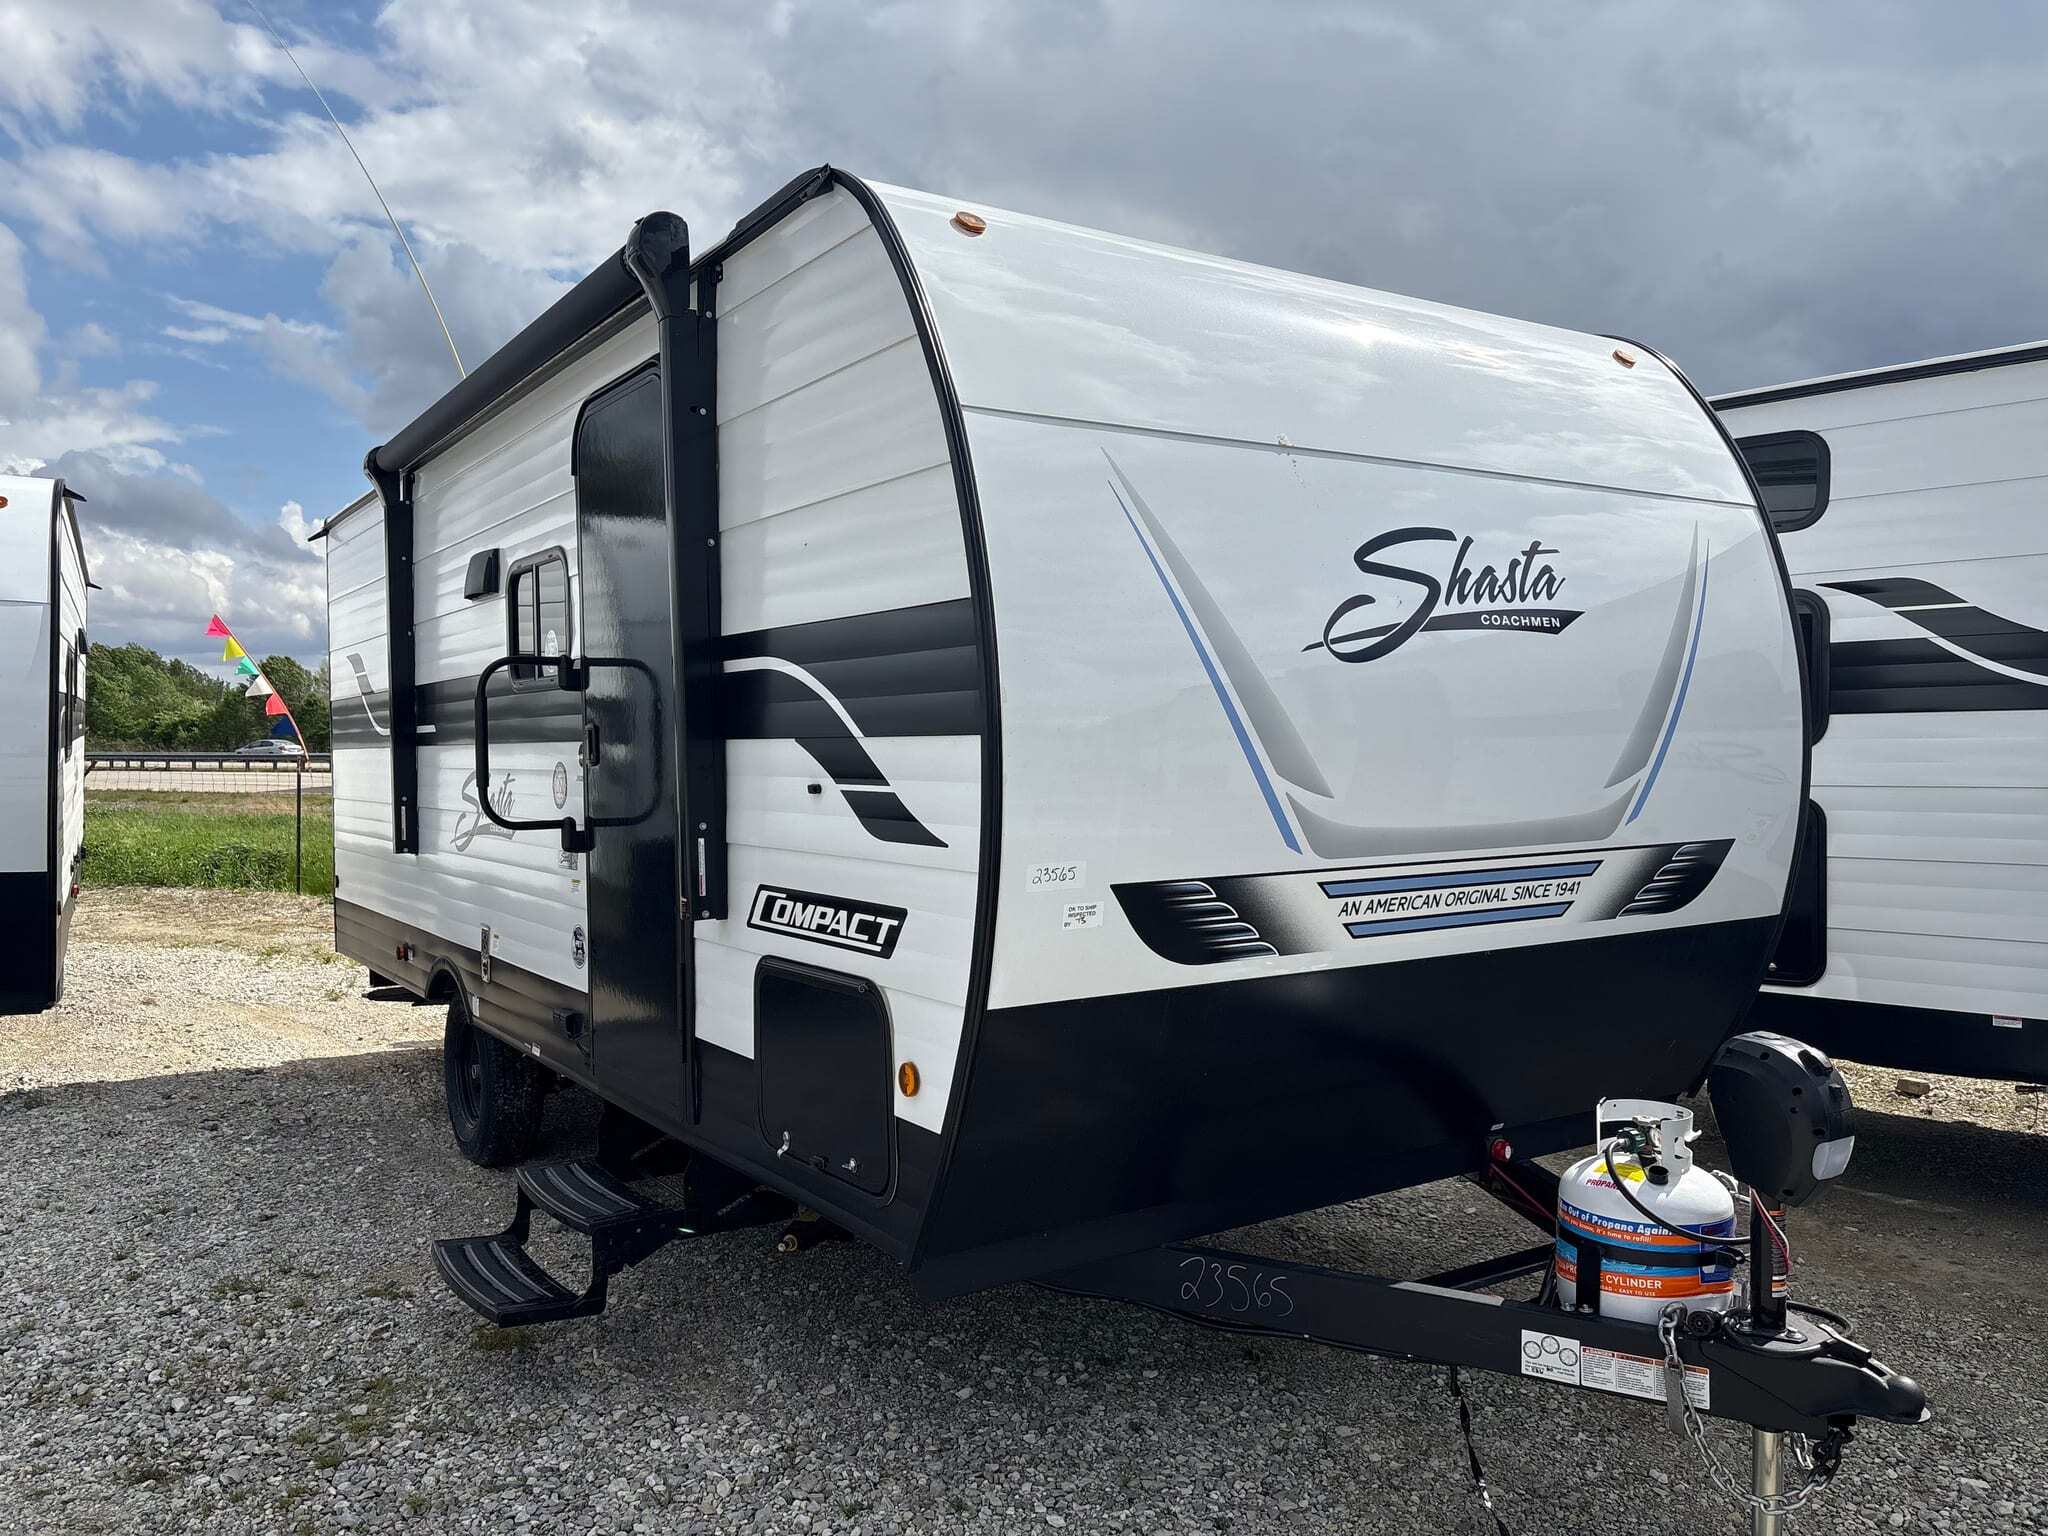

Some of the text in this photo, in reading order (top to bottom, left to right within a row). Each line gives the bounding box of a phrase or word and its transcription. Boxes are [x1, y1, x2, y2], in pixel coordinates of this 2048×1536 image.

[1324, 526, 1566, 664] Shasta
[1481, 614, 1561, 628] COACHMEN
[1032, 866, 1077, 885] 23565
[1337, 880, 1582, 917] AN AMERICAN ORIGINAL SINCE 1941
[750, 889, 899, 952] COMPACT
[1585, 1178, 1618, 1190] PROPAN
[1568, 1206, 1580, 1218] Out
[1581, 1213, 1590, 1221] of
[1592, 1215, 1634, 1232] Propane
[1607, 1230, 1622, 1239] time
[1179, 1256, 1295, 1317] 23565
[1605, 1274, 1662, 1289] CYLINDER
